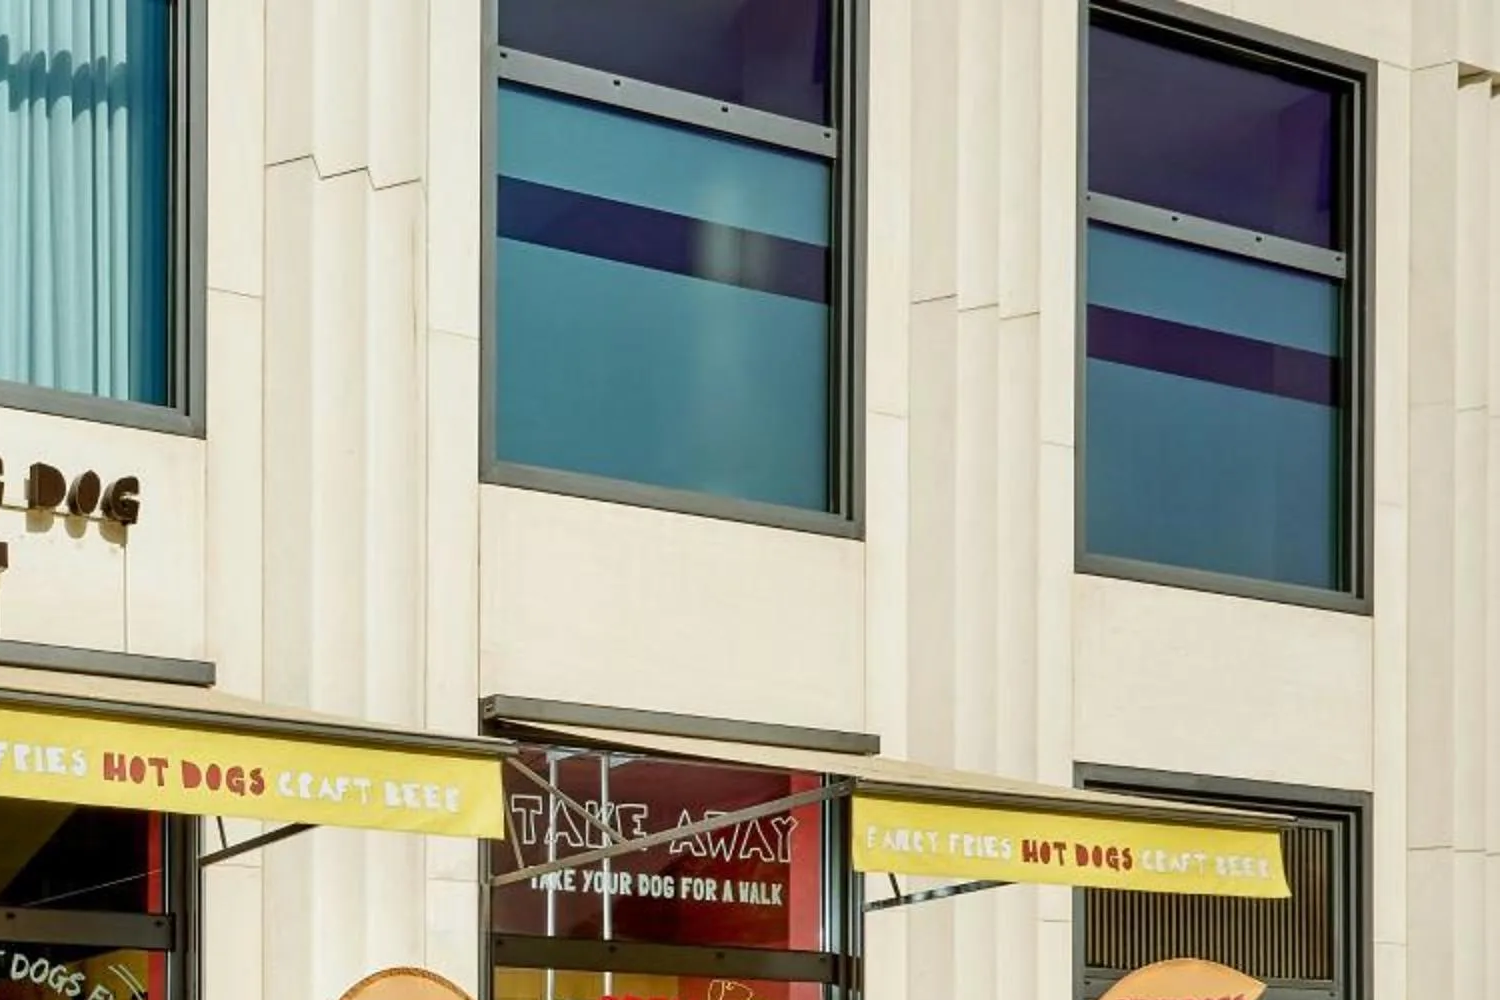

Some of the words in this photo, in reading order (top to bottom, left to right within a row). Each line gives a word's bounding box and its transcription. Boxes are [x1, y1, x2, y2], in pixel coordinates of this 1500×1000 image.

[27, 461, 141, 525] DOG
[102, 751, 170, 787] HOT
[180, 759, 266, 796] DOGS
[276, 770, 372, 805] CRAFT
[383, 779, 462, 814] BEER
[511, 794, 649, 851] TAKE
[669, 807, 799, 864] AWAY
[866, 825, 939, 854] FANCY
[947, 831, 1013, 861] FRIES
[1021, 838, 1068, 866] HOT
[1075, 843, 1134, 871] DOGS
[1141, 849, 1207, 876] CRAFT
[1215, 856, 1272, 880] BEER
[581, 868, 633, 896] YOUR
[637, 872, 676, 899] DOG
[680, 876, 718, 902] FOR
[721, 879, 735, 903] A
[738, 880, 784, 907] WALK
[10, 952, 87, 998] DOGS
